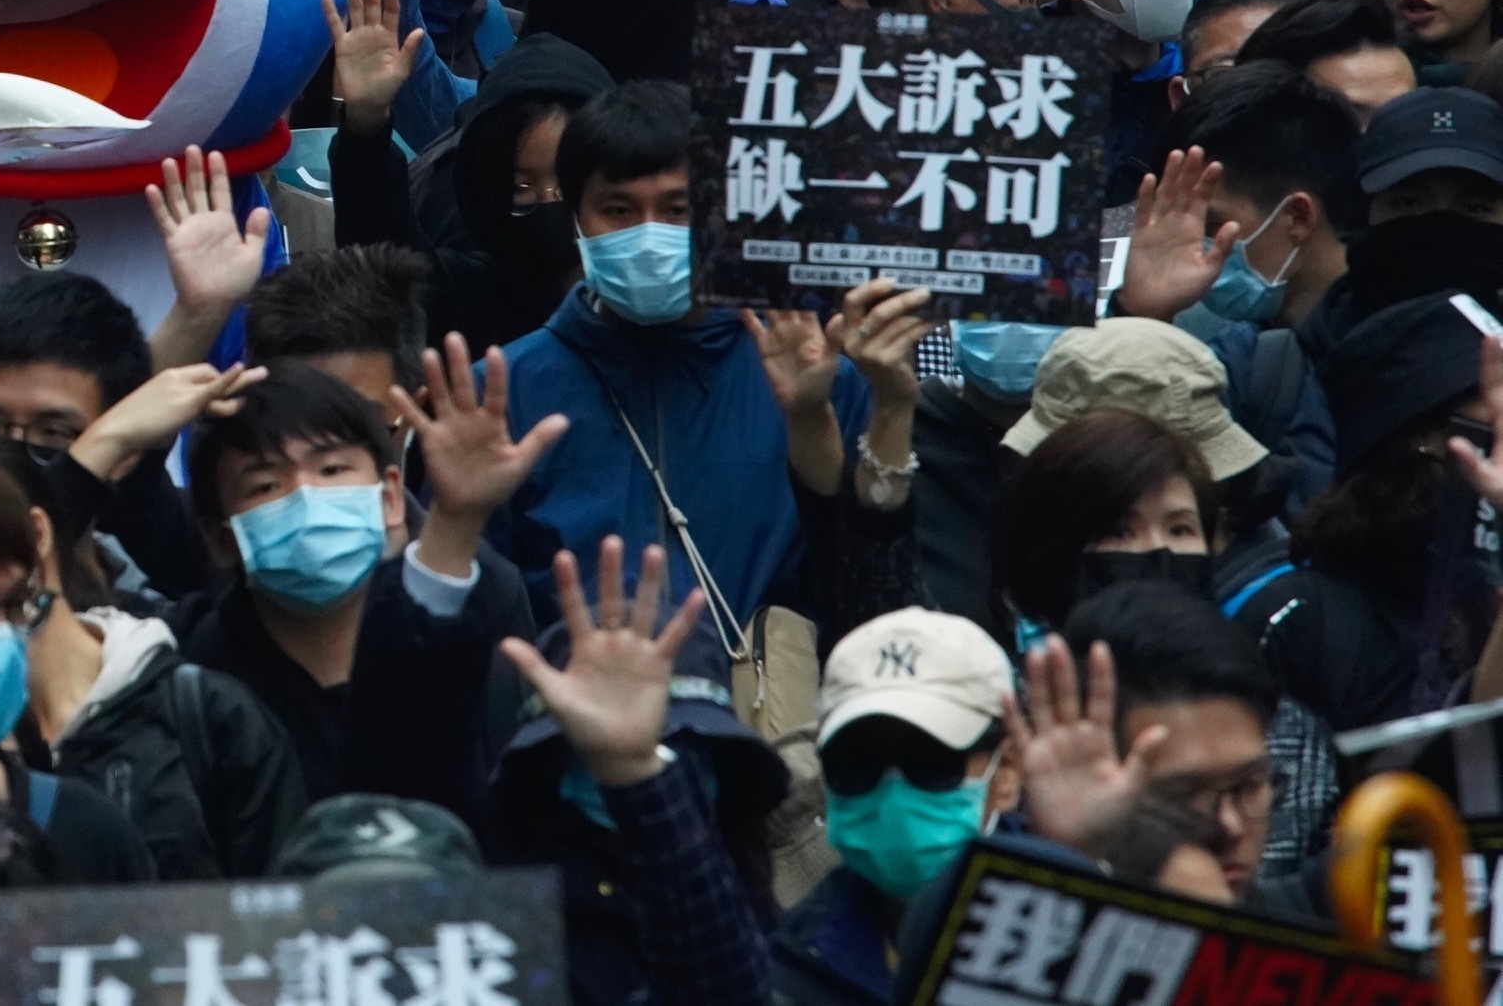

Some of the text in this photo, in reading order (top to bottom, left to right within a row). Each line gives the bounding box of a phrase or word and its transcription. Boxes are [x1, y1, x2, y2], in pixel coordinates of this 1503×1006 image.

[726, 41, 1078, 141] 五大訴求
[724, 134, 1072, 239] 缺一不可
